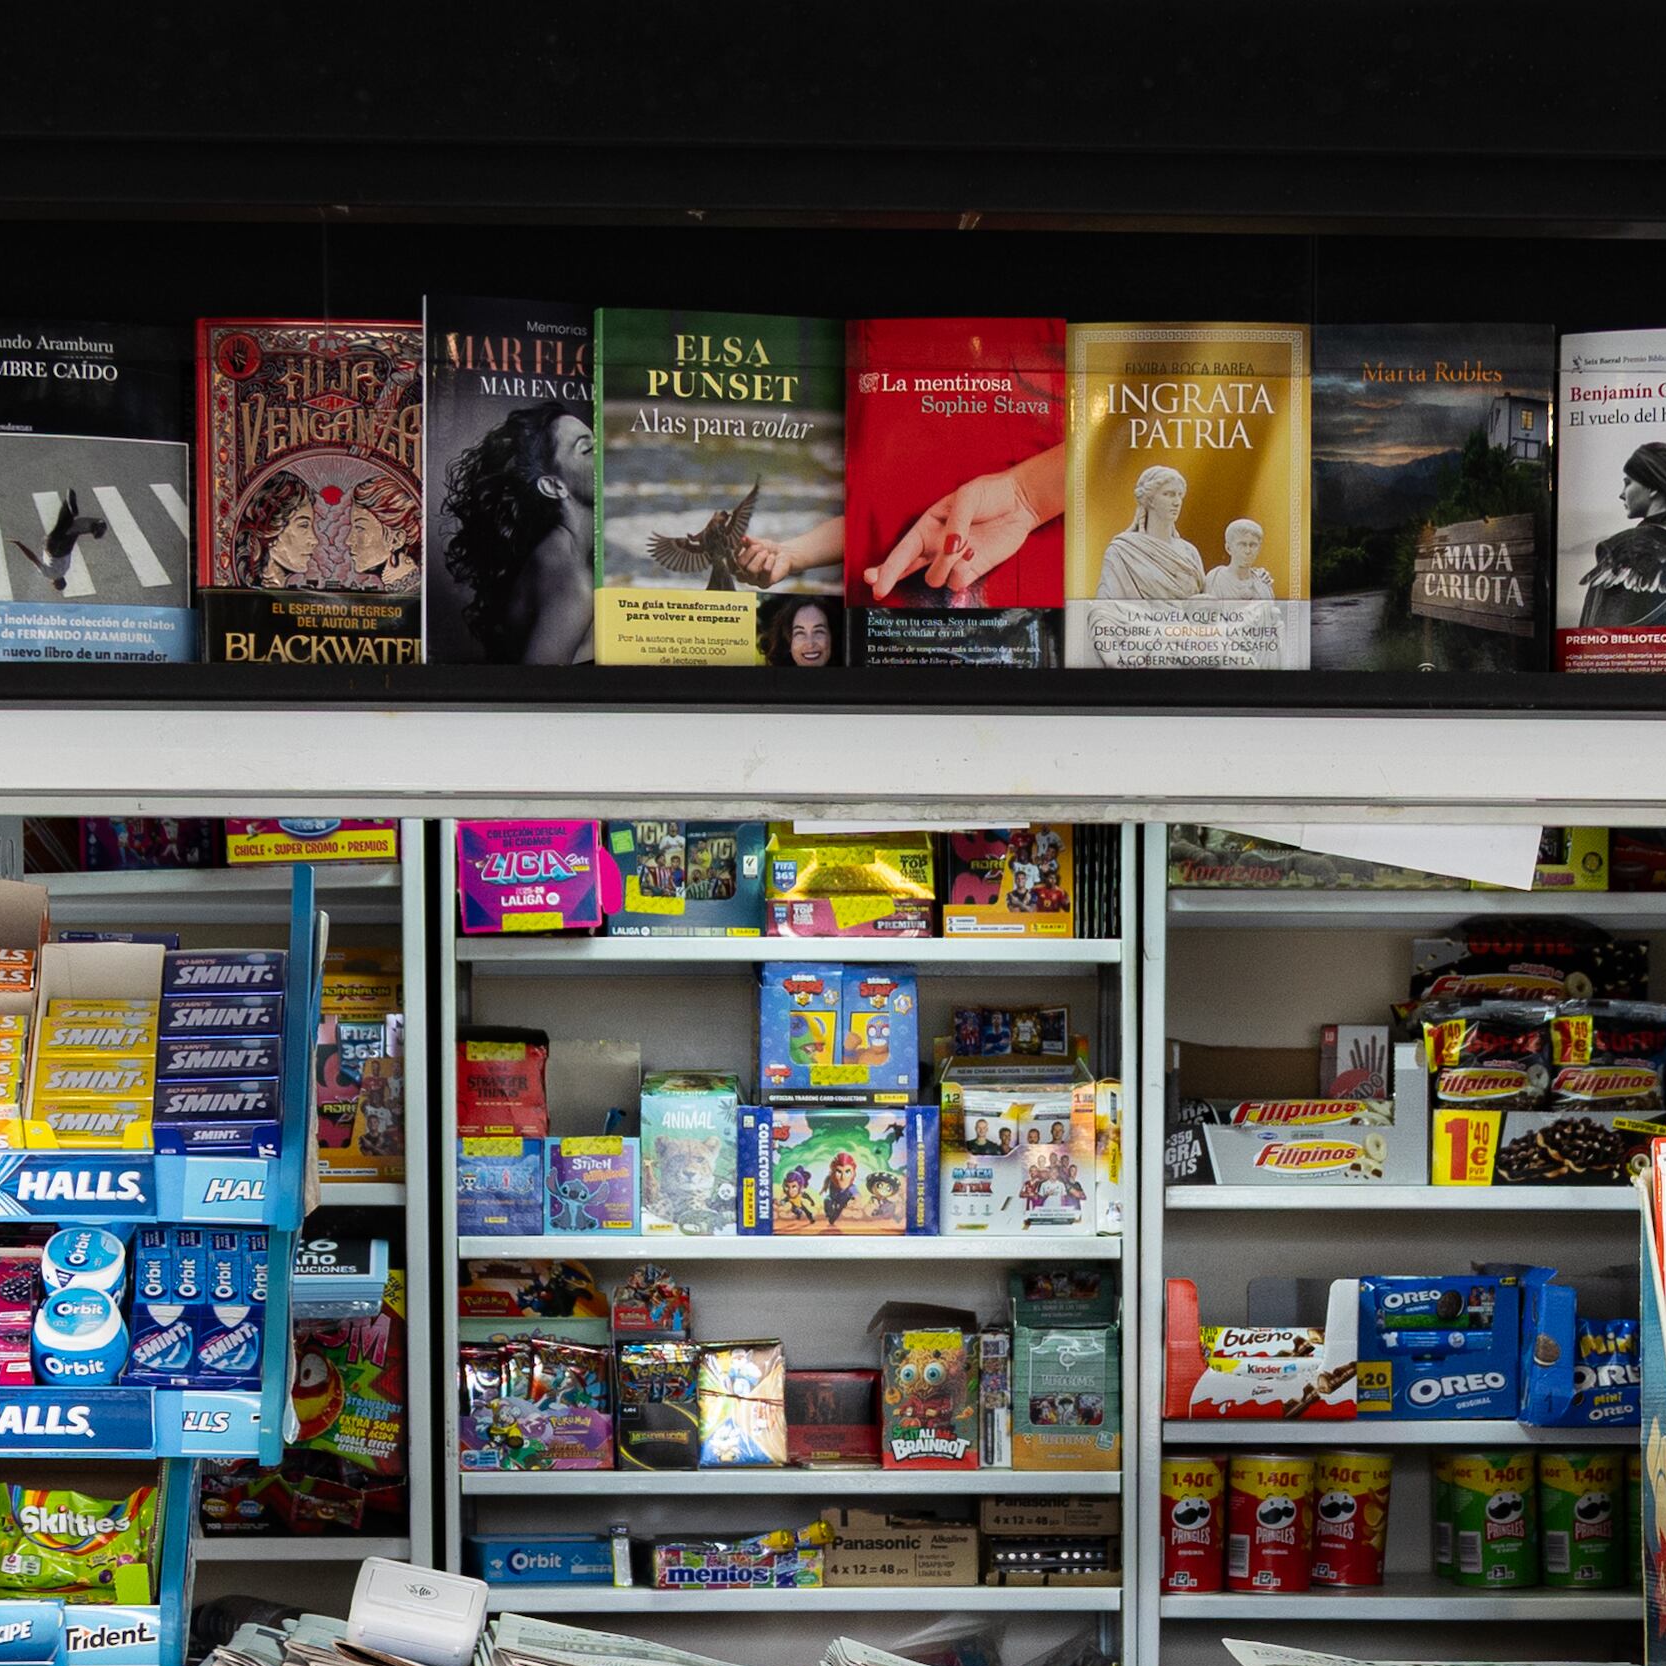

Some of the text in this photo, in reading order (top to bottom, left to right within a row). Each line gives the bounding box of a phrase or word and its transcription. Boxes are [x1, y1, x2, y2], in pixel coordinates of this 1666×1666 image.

[37, 335, 114, 354] Aramburu
[676, 335, 770, 365] ELSA
[53, 359, 118, 382] CAÍDO
[647, 369, 799, 402] PUNSET
[881, 374, 1012, 393] La mentirosa
[1570, 382, 1653, 404] Benjamín
[921, 396, 1050, 417] Sophie Stava
[1107, 383, 1275, 415] INGRATA
[631, 408, 813, 442] Alas para volar
[1570, 410, 1584, 426] El
[1589, 410, 1628, 425] vuelo
[1634, 407, 1657, 423] del
[1129, 418, 1253, 449] PATRIA
[173, 966, 269, 984] SMINT
[1258, 1143, 1357, 1166] Filipinos
[45, 1358, 105, 1376] Orbit
[1409, 1373, 1506, 1402] OREO
[21, 1506, 131, 1538] Skittles
[832, 1535, 920, 1551] Panasonic
[1171, 1526, 1210, 1544] PRINGLES
[507, 1548, 562, 1572] Orbit
[667, 1566, 772, 1586] mentos
